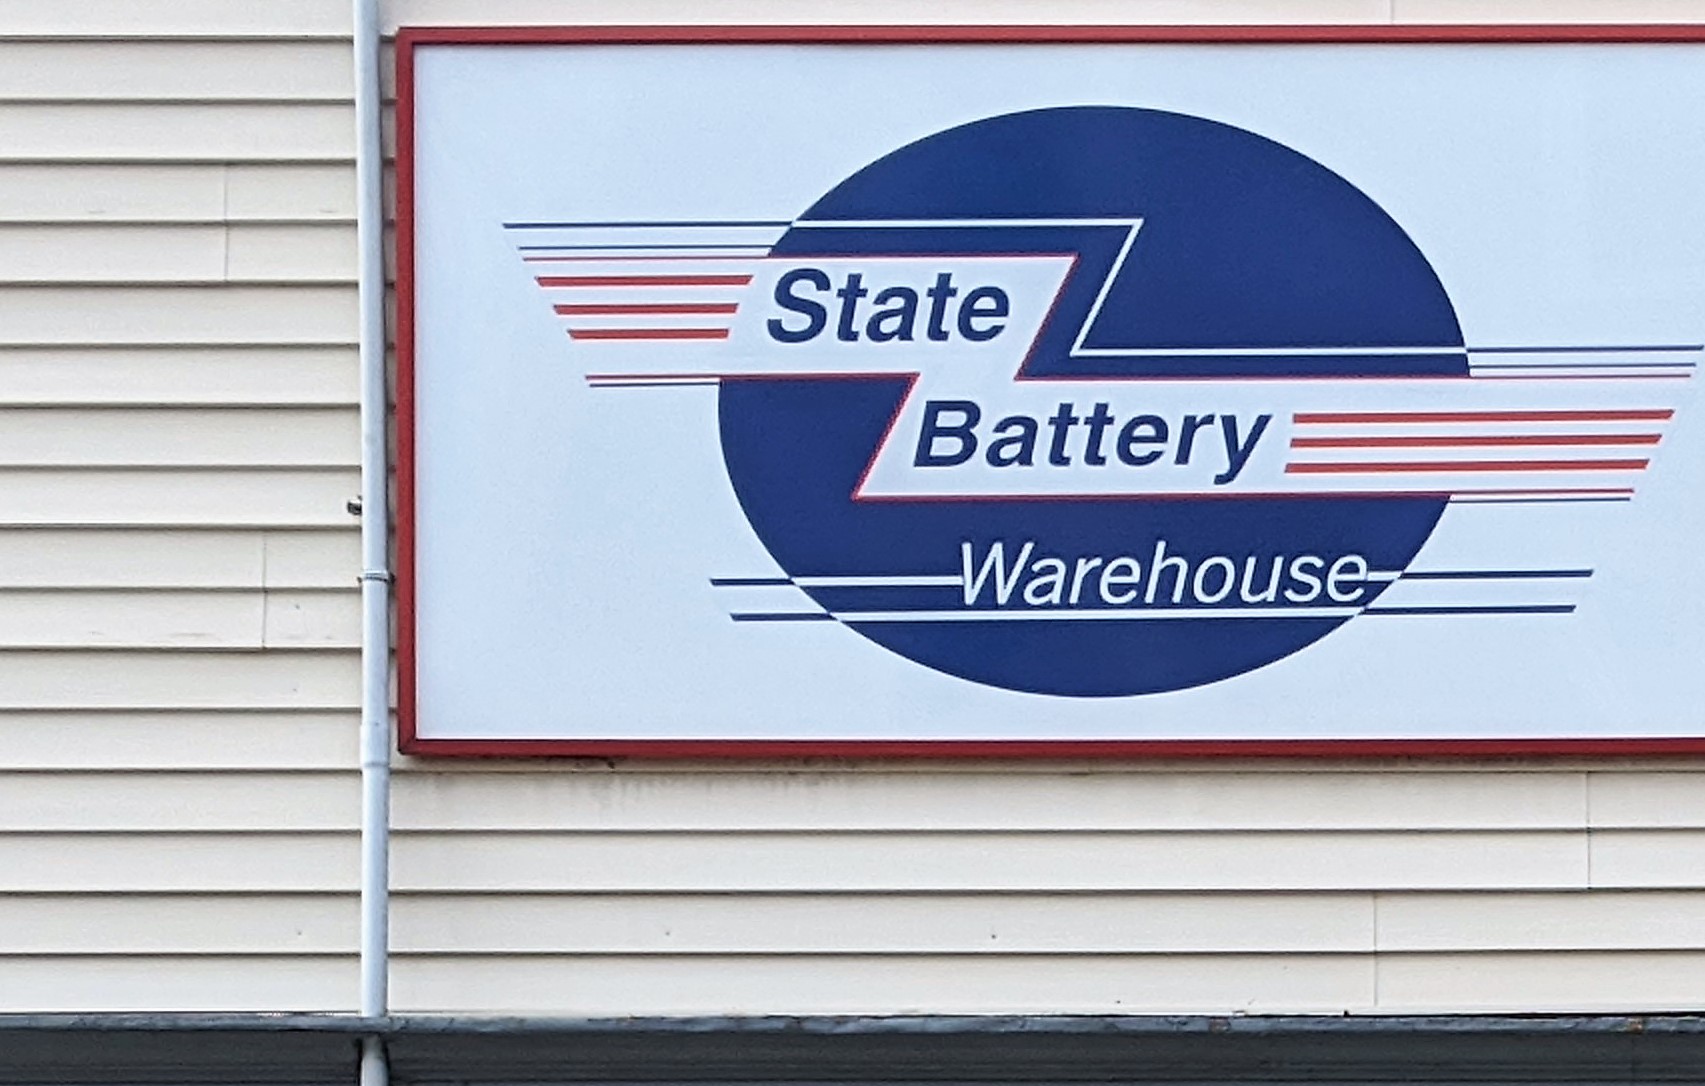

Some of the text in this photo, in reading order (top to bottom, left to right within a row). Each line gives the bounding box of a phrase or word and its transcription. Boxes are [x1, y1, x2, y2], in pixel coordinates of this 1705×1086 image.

[766, 267, 1010, 344] State
[913, 398, 1273, 486] Battery
[958, 540, 1370, 607] Warehouse
